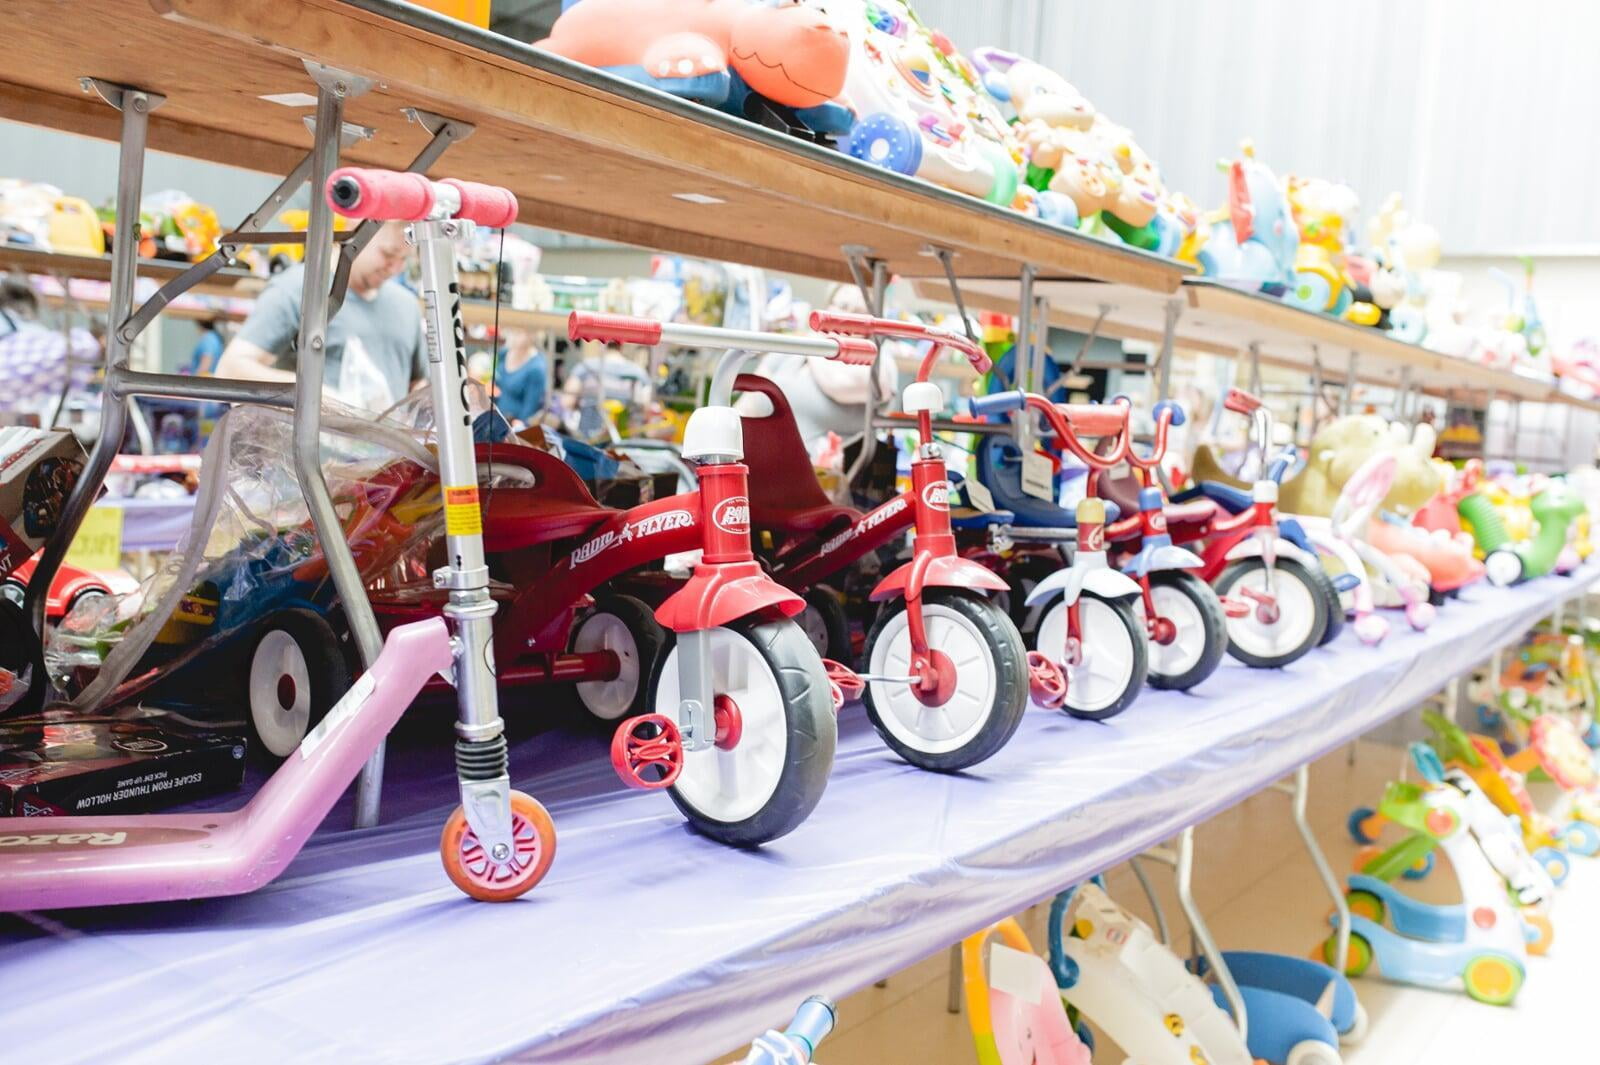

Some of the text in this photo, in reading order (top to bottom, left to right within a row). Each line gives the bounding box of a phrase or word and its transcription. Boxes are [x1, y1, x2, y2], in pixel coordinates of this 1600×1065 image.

[866, 499, 908, 530] FLYER
[569, 510, 695, 570] RADIO FLYER
[76, 772, 202, 810] ESCAPE FROM THUNDER HOLLOW
